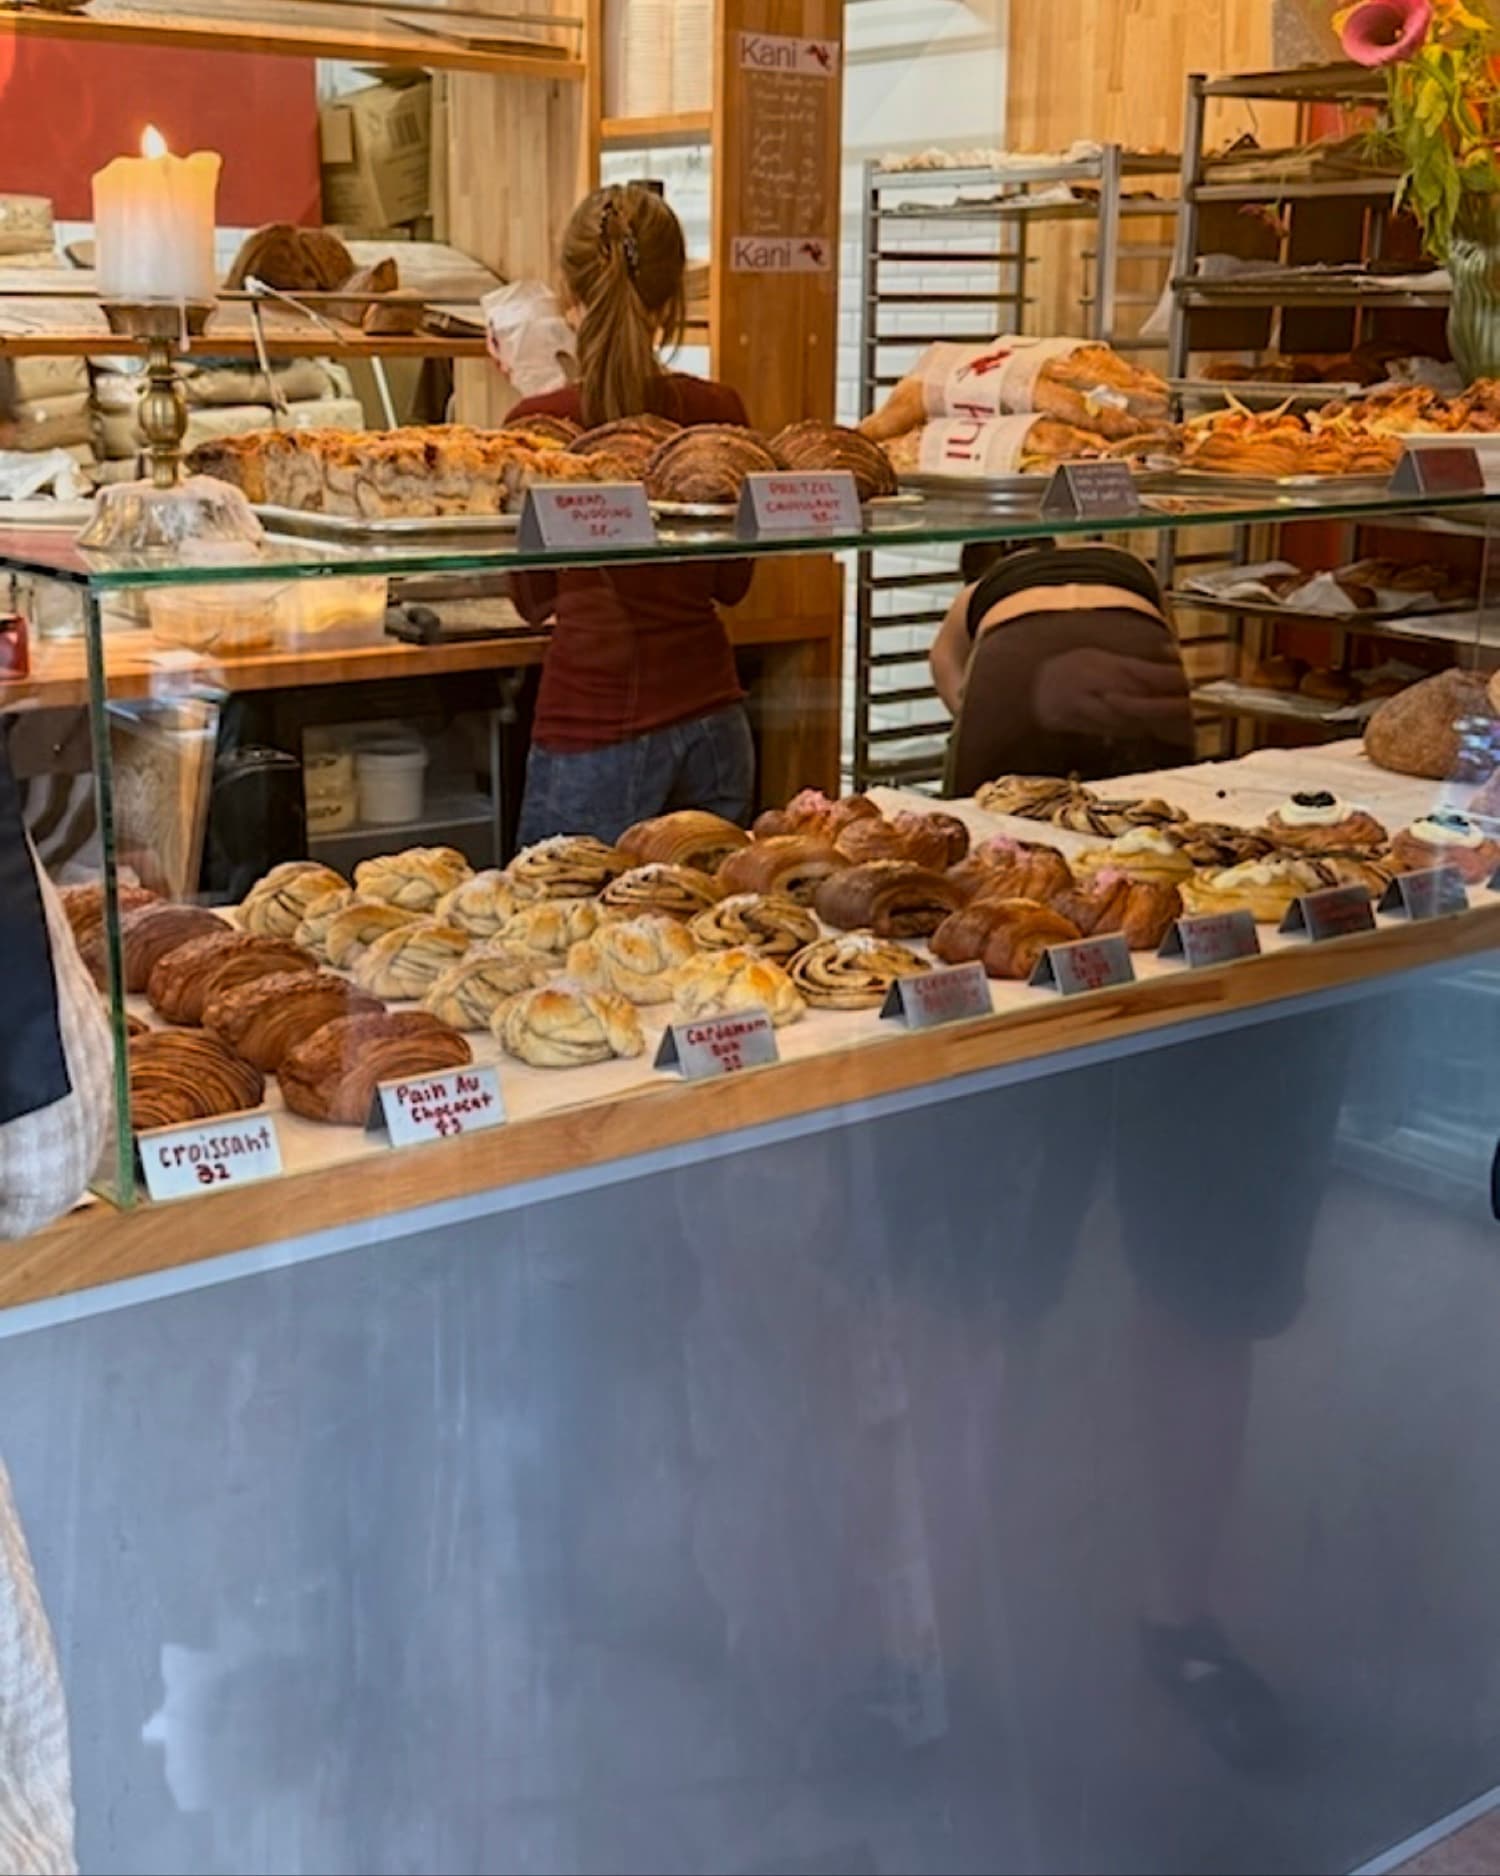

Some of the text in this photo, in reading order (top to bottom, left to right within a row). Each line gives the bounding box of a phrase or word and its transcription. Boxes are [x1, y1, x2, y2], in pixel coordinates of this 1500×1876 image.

[741, 37, 797, 68] Kani
[735, 240, 791, 268] Kani
[396, 1083, 448, 1107] Pain
